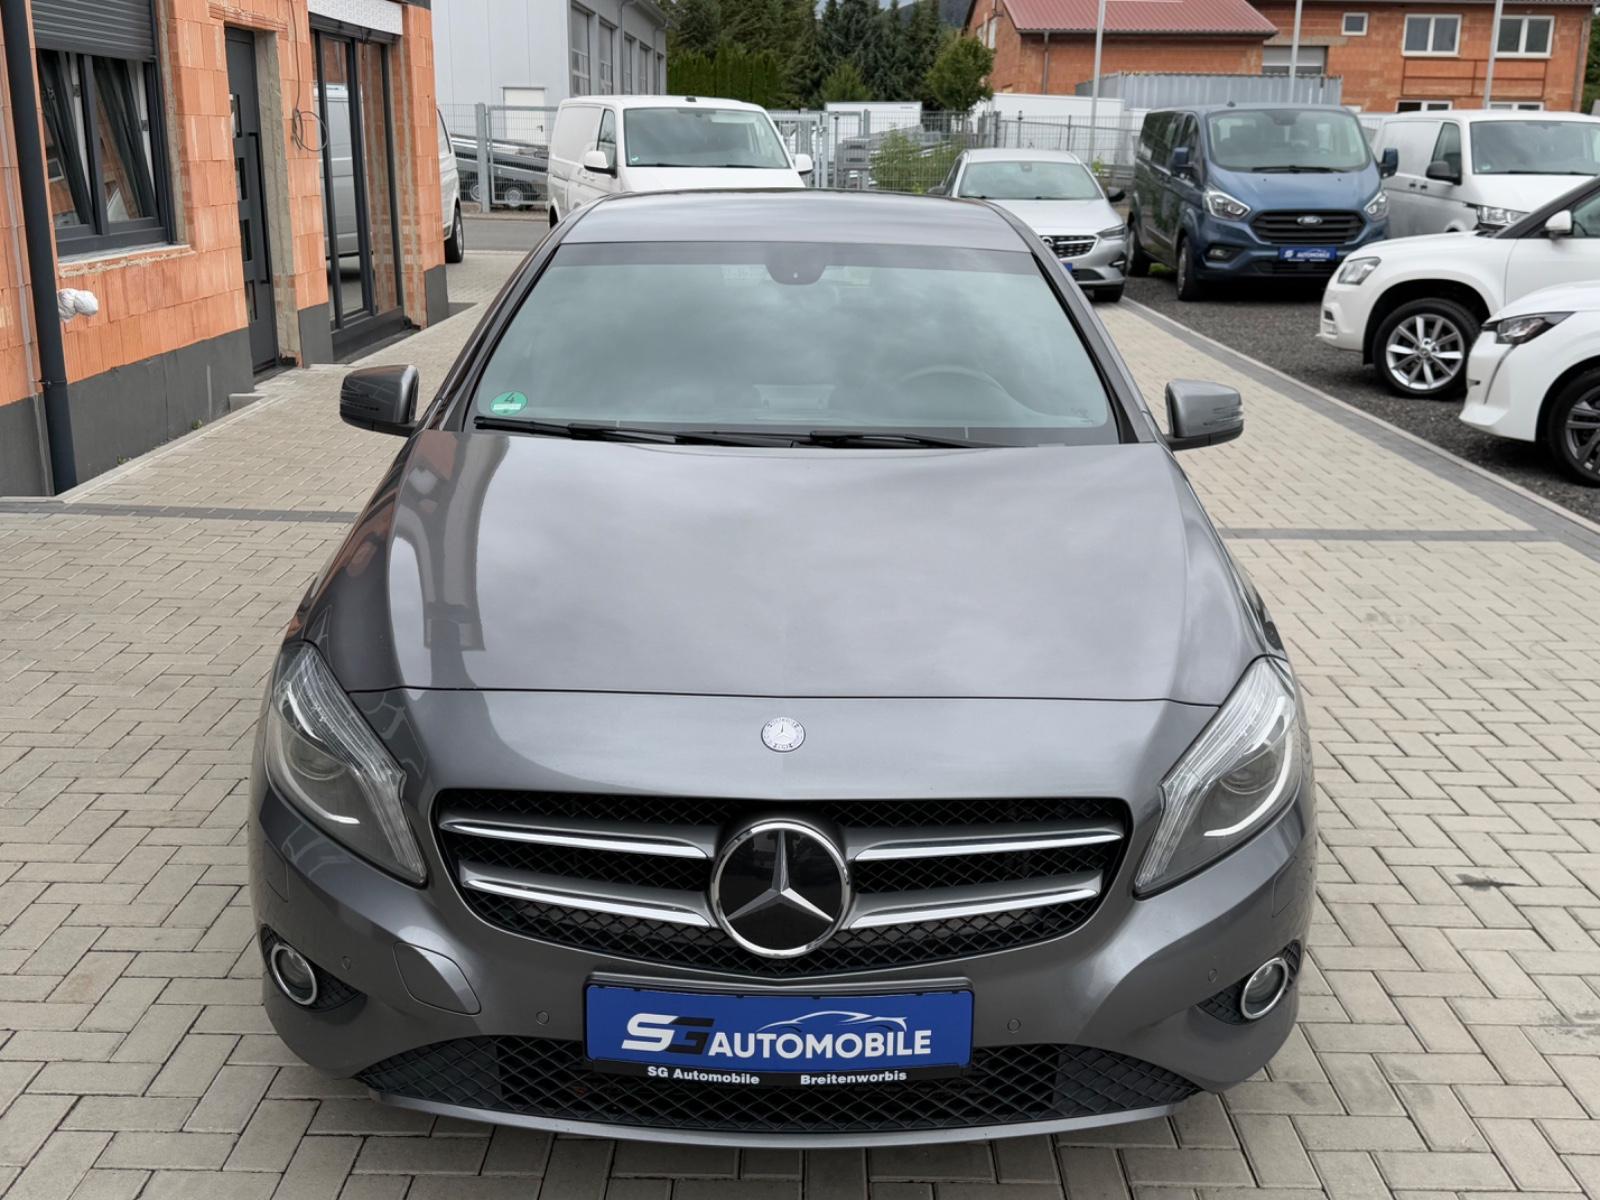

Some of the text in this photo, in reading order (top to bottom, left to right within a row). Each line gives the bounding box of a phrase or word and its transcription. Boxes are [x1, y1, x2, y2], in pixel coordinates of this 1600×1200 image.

[504, 391, 515, 404] 4
[621, 1012, 932, 1059] SG AUTOMOBILE
[647, 1066, 760, 1085] SG Automobile
[800, 1070, 908, 1086] Breitenworbis
